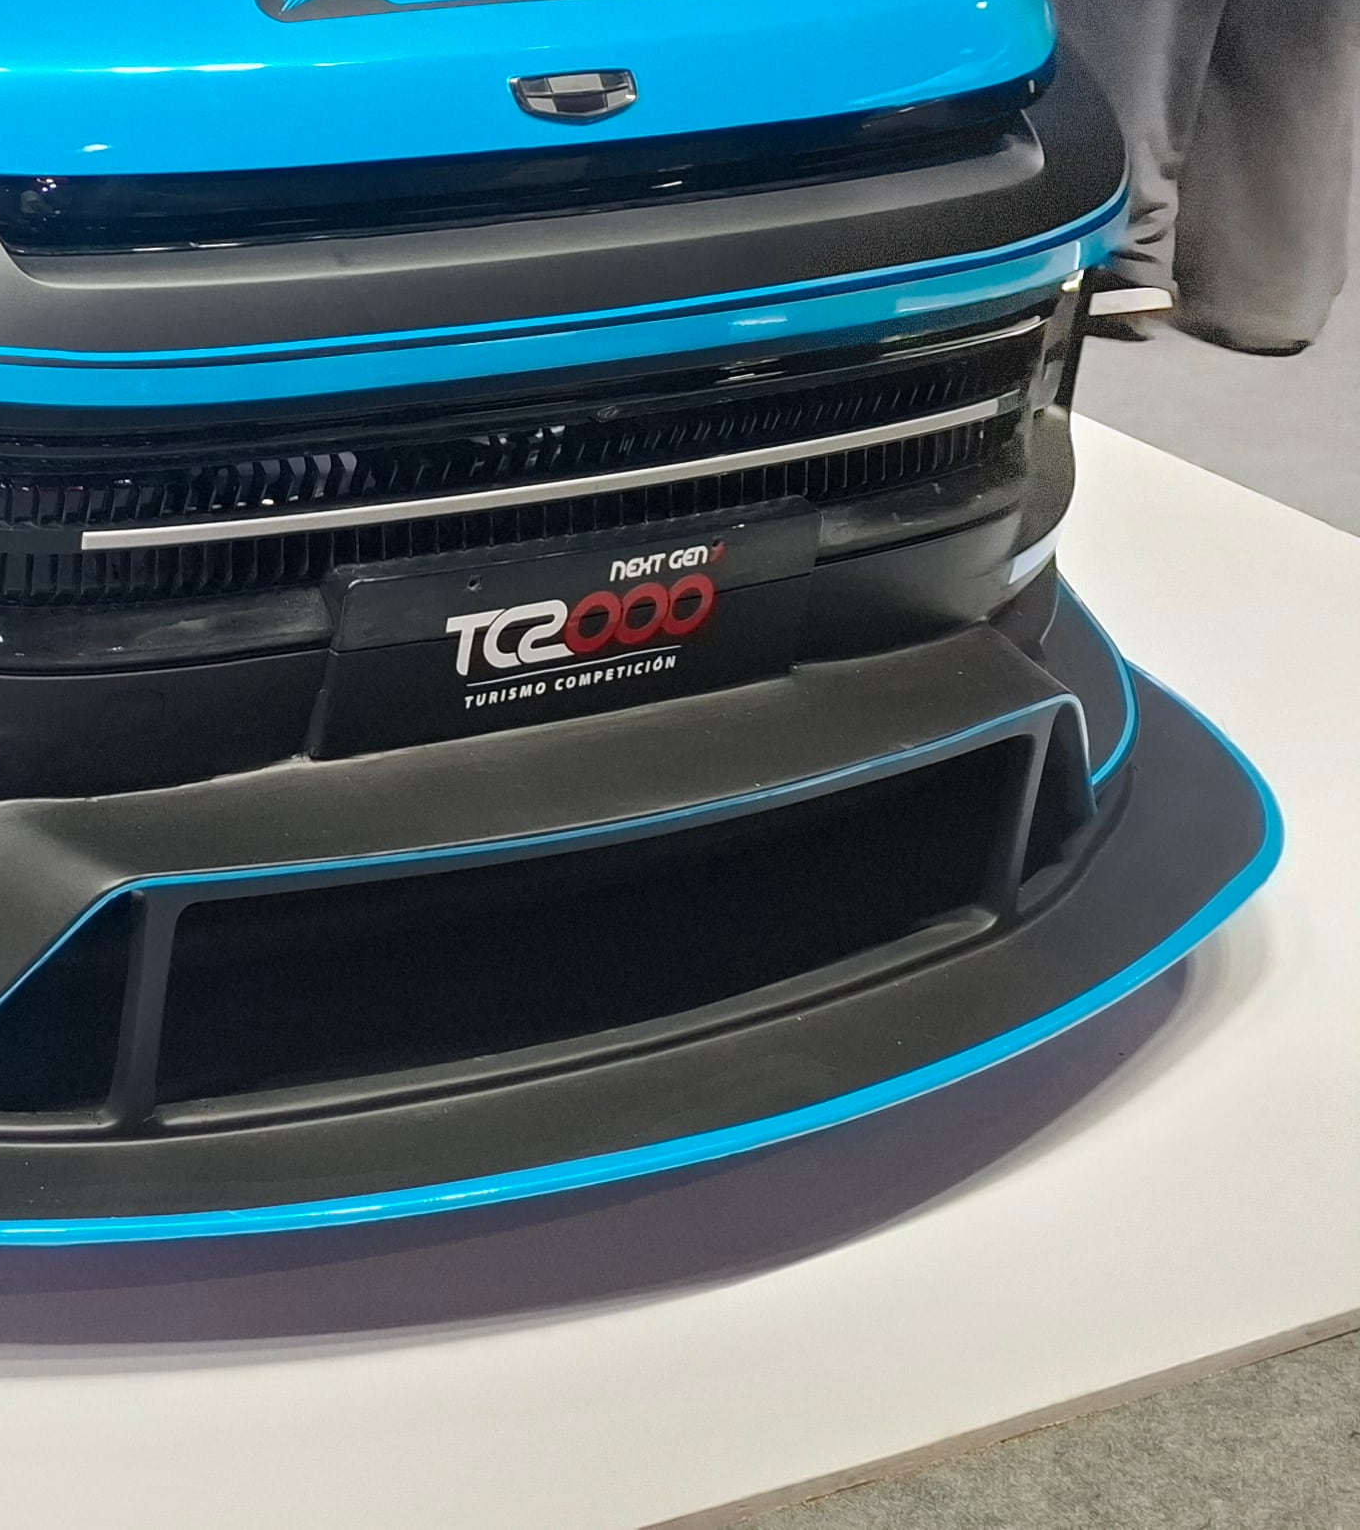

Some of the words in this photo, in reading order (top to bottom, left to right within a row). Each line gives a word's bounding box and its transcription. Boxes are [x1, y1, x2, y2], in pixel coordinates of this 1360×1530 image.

[609, 552, 667, 582] NEXT
[668, 545, 708, 570] GEN
[445, 573, 715, 676] TC2000
[464, 682, 546, 709] TURISMO
[554, 655, 677, 691] COMPETICIÓN
